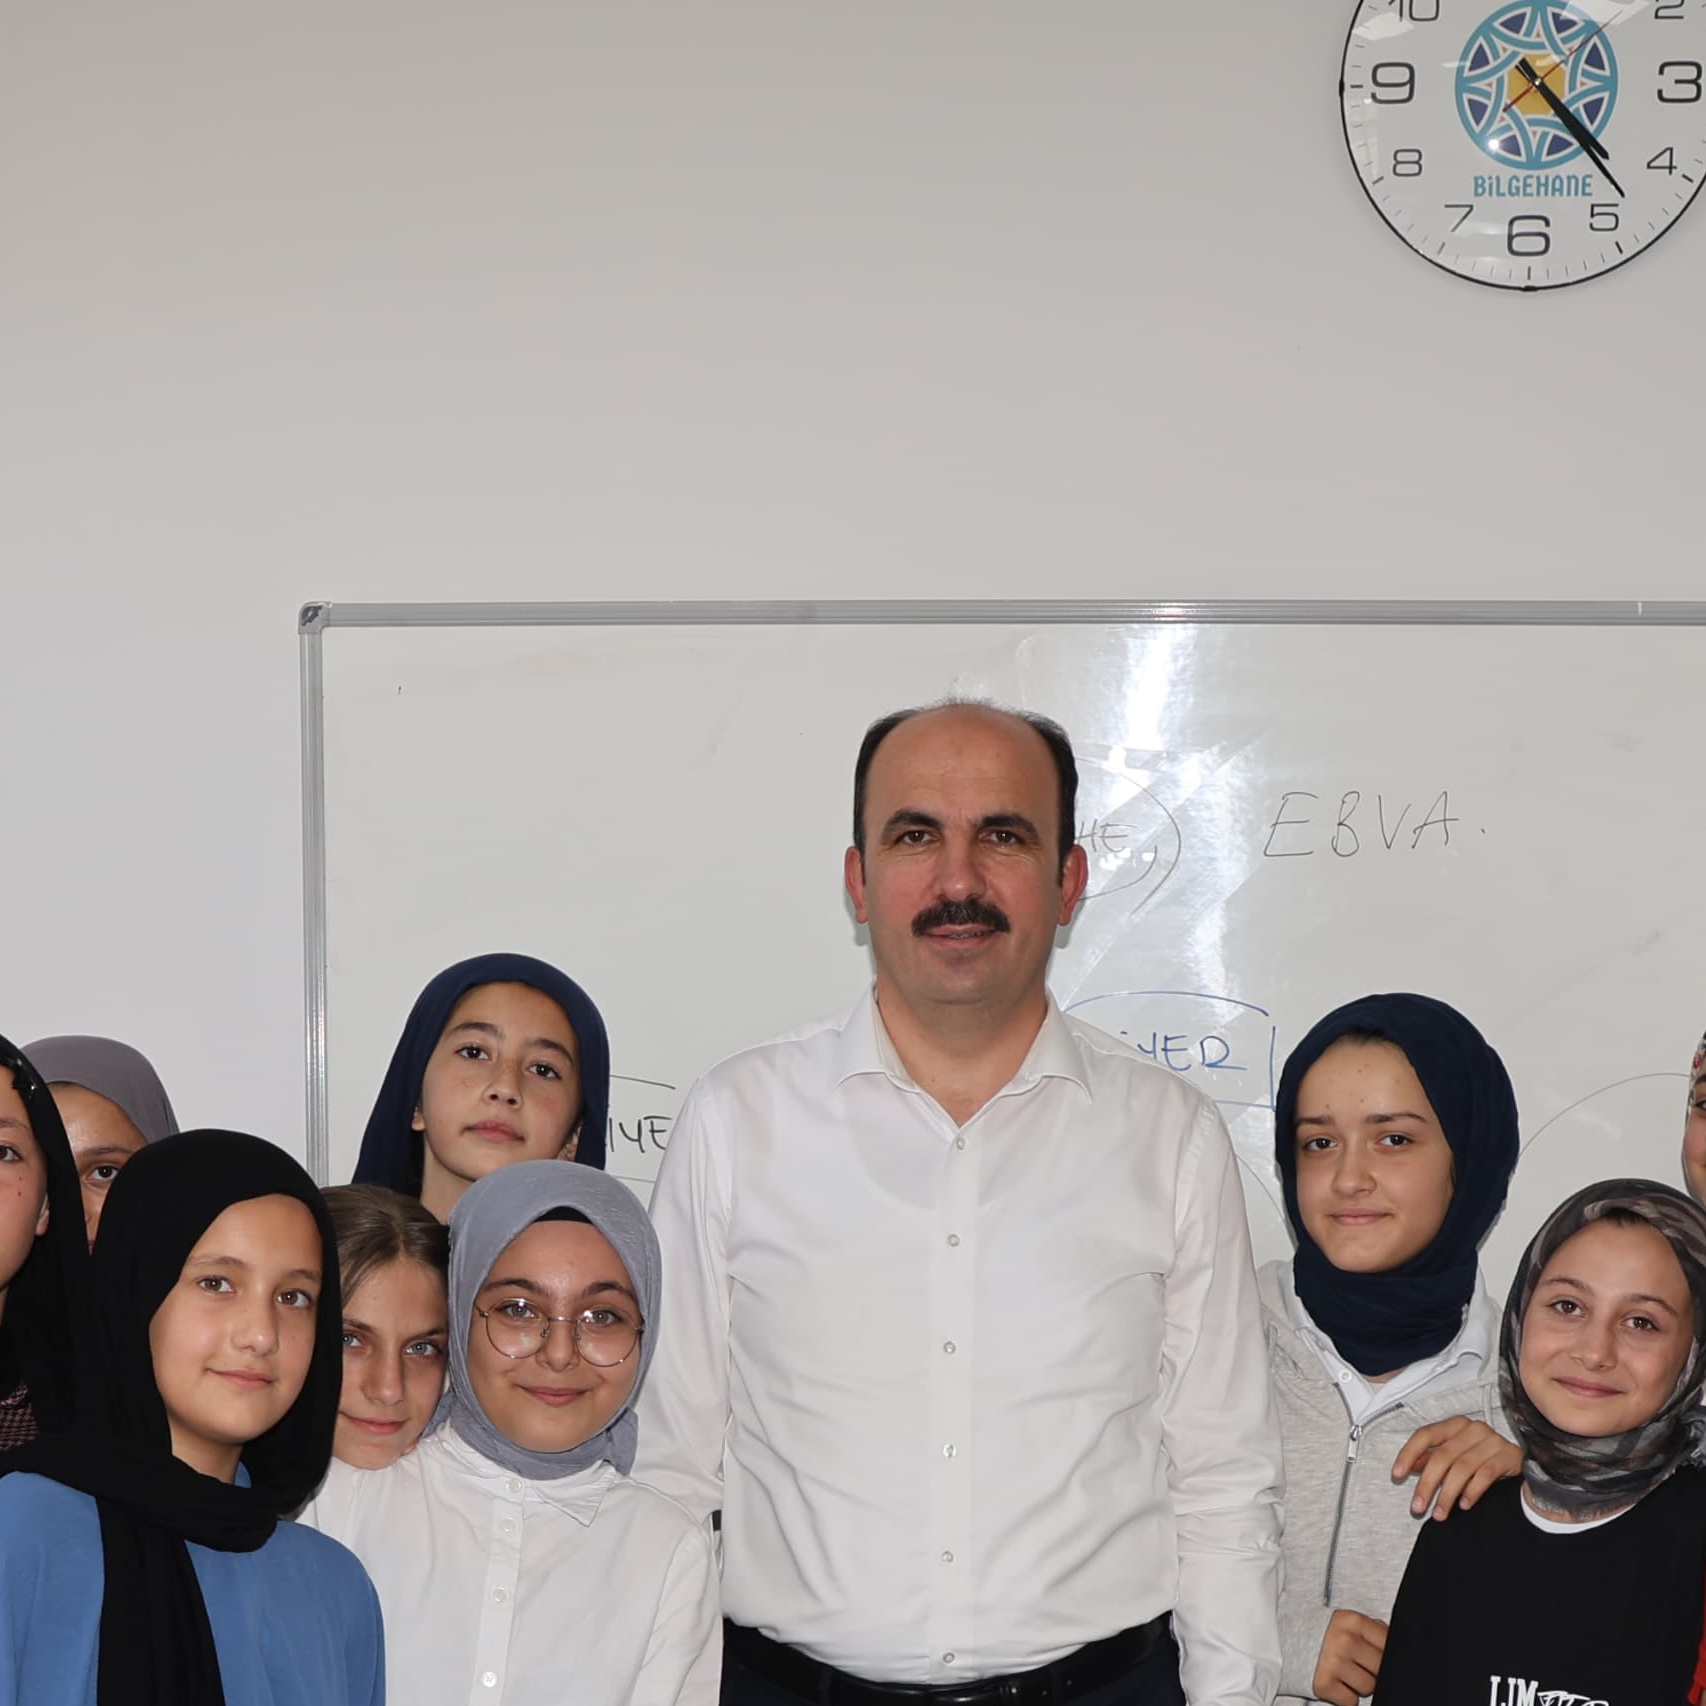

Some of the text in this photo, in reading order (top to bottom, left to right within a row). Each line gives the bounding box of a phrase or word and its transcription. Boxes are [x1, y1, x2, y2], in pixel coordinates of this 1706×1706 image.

[1371, 62, 1416, 104] 9
[1657, 61, 1703, 103] 3
[1393, 148, 1423, 177] 8
[1646, 146, 1677, 175] 4
[1444, 204, 1474, 232] 7
[1590, 203, 1619, 231] 5
[1507, 215, 1551, 257] 6
